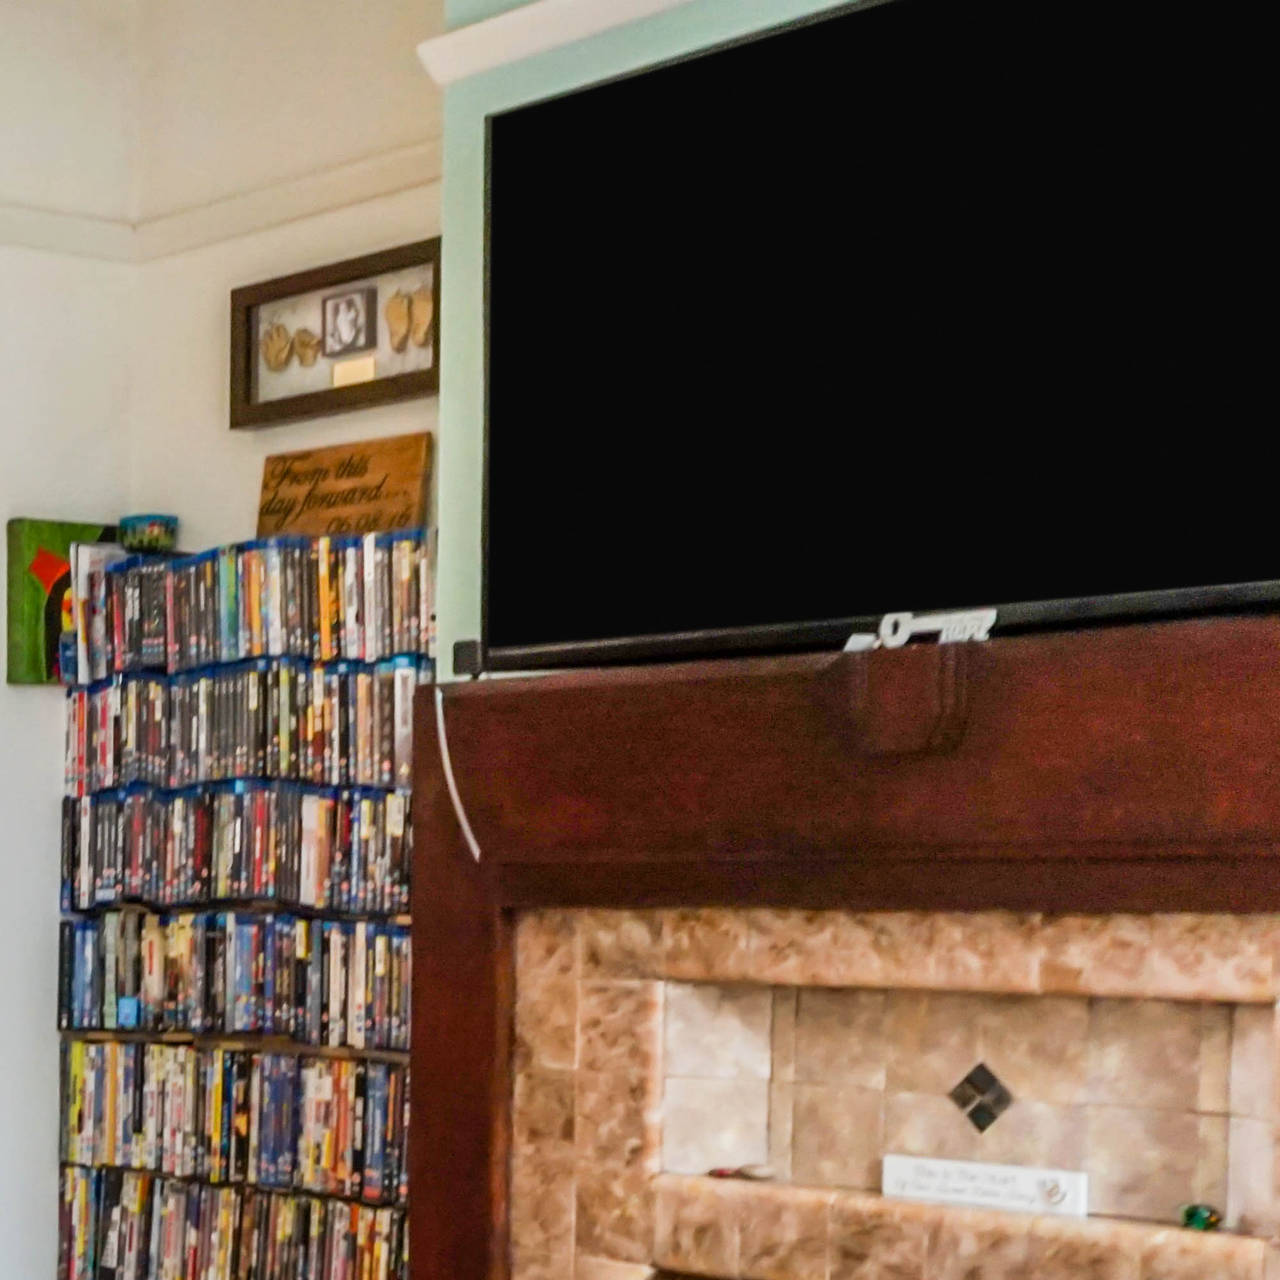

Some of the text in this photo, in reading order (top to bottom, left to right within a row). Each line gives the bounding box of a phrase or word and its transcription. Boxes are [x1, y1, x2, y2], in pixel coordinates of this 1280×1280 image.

[263, 452, 372, 489] From this
[260, 488, 297, 531] day
